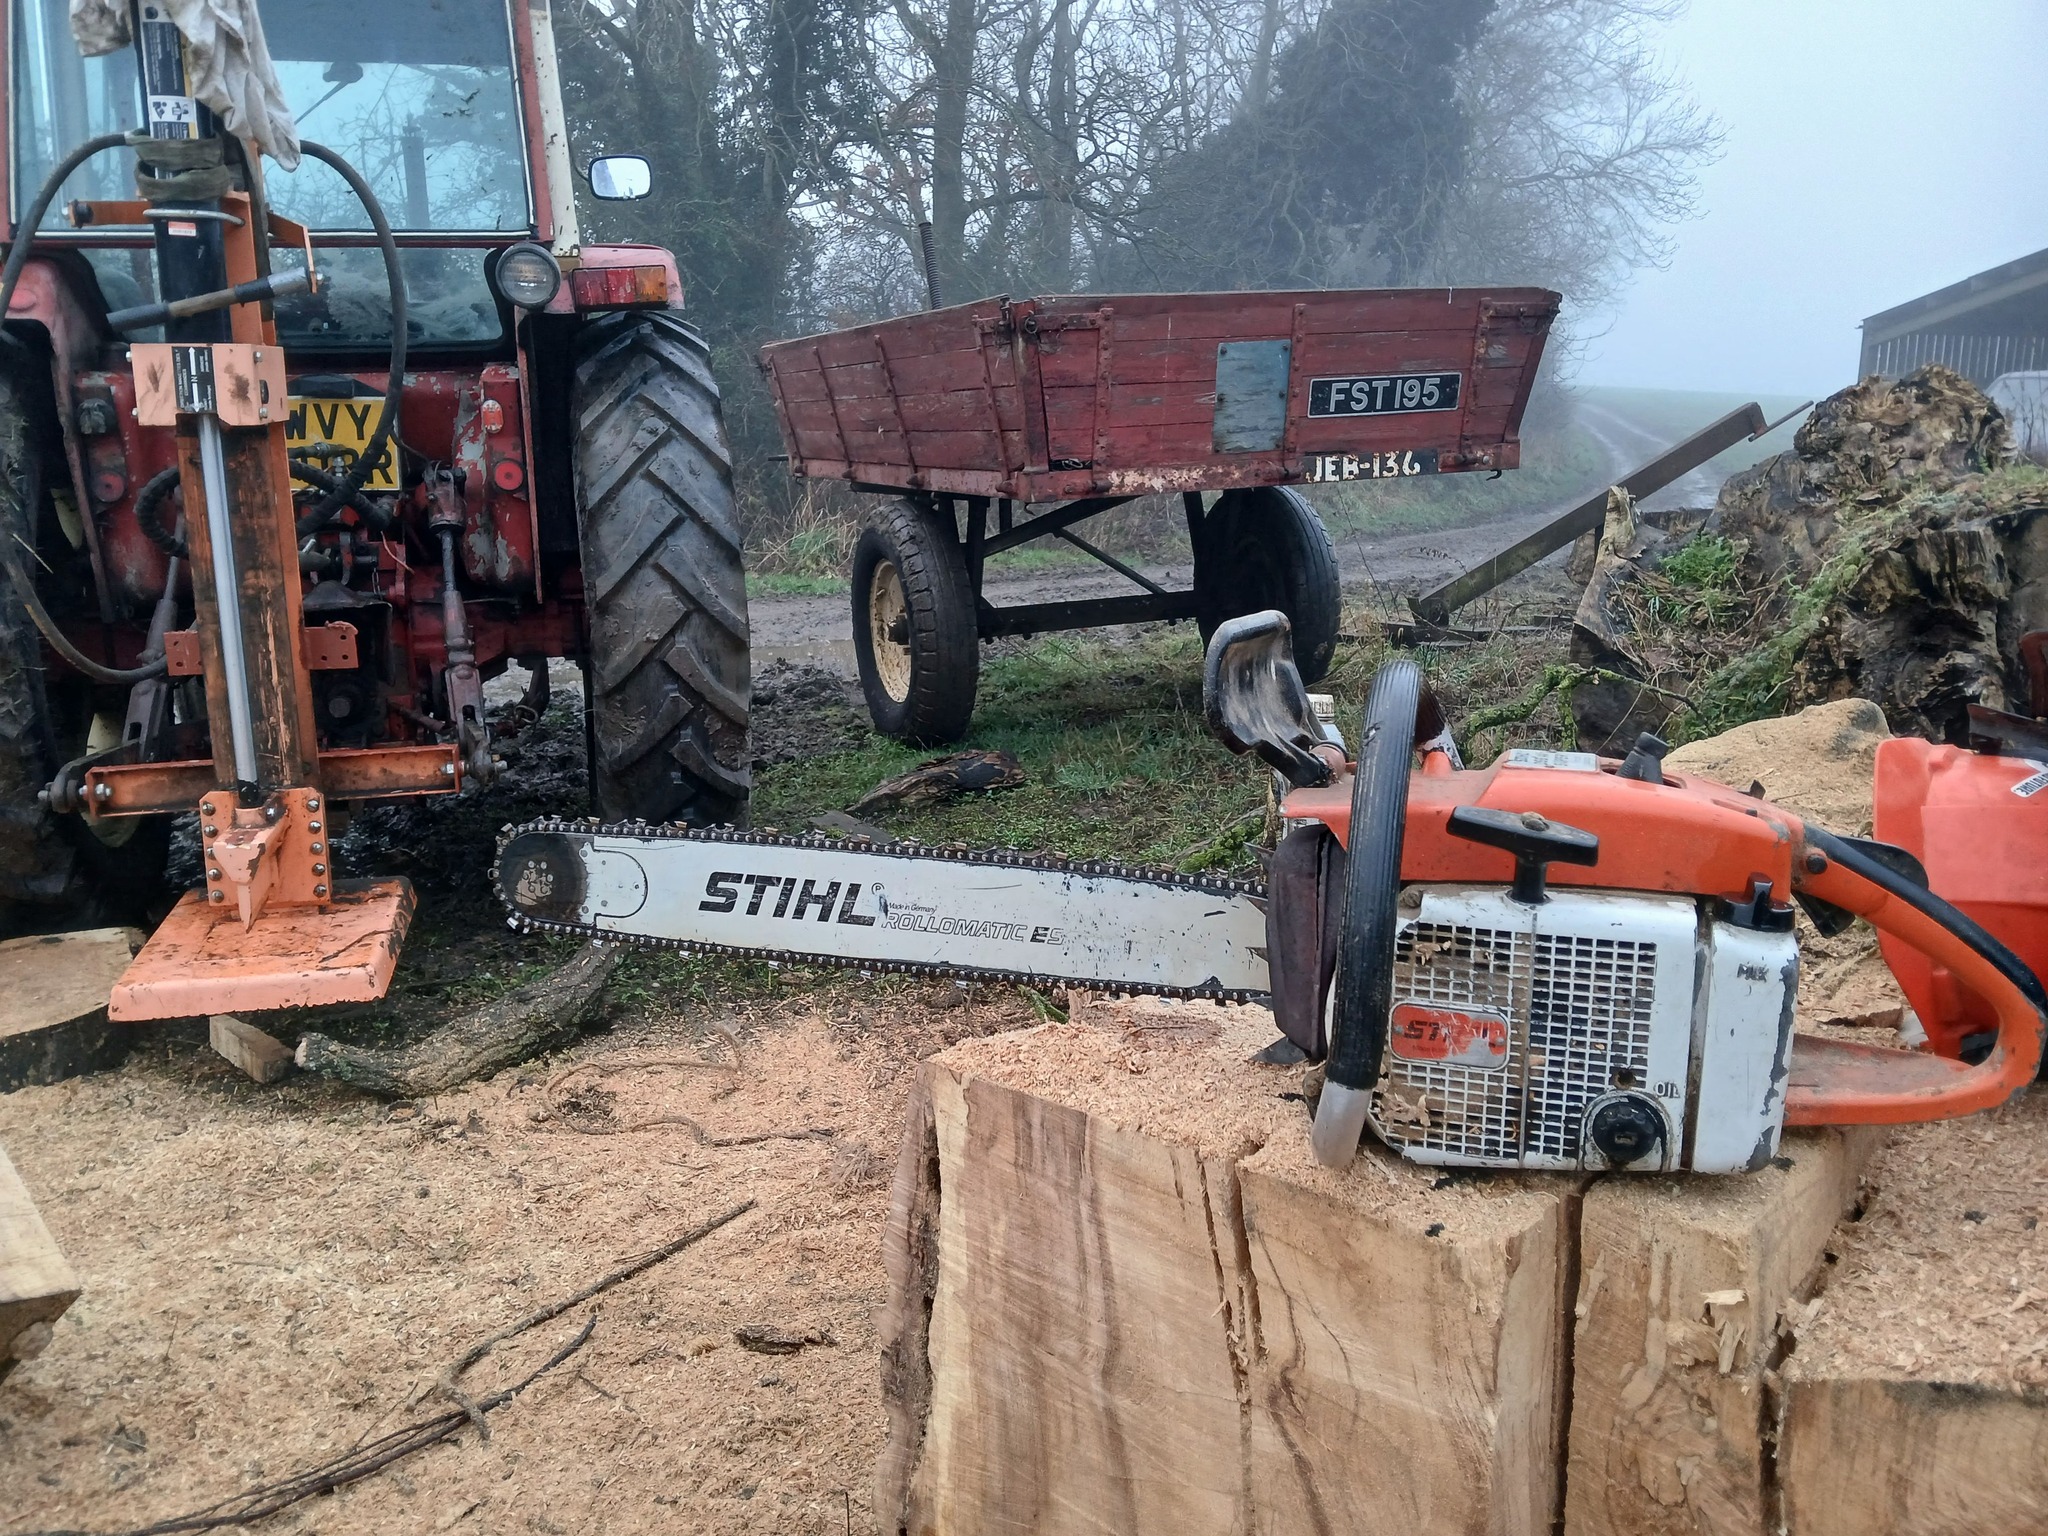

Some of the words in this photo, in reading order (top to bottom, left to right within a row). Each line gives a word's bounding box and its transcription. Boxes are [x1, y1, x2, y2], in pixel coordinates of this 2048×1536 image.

[1329, 380, 1390, 413] FST
[1394, 377, 1441, 409] 195
[285, 403, 371, 440] WVY
[699, 871, 876, 927] STIHL
[881, 912, 1027, 943] ROLLOMATIC
[1030, 926, 1064, 946] ES
[1653, 1081, 1681, 1099] OIL
